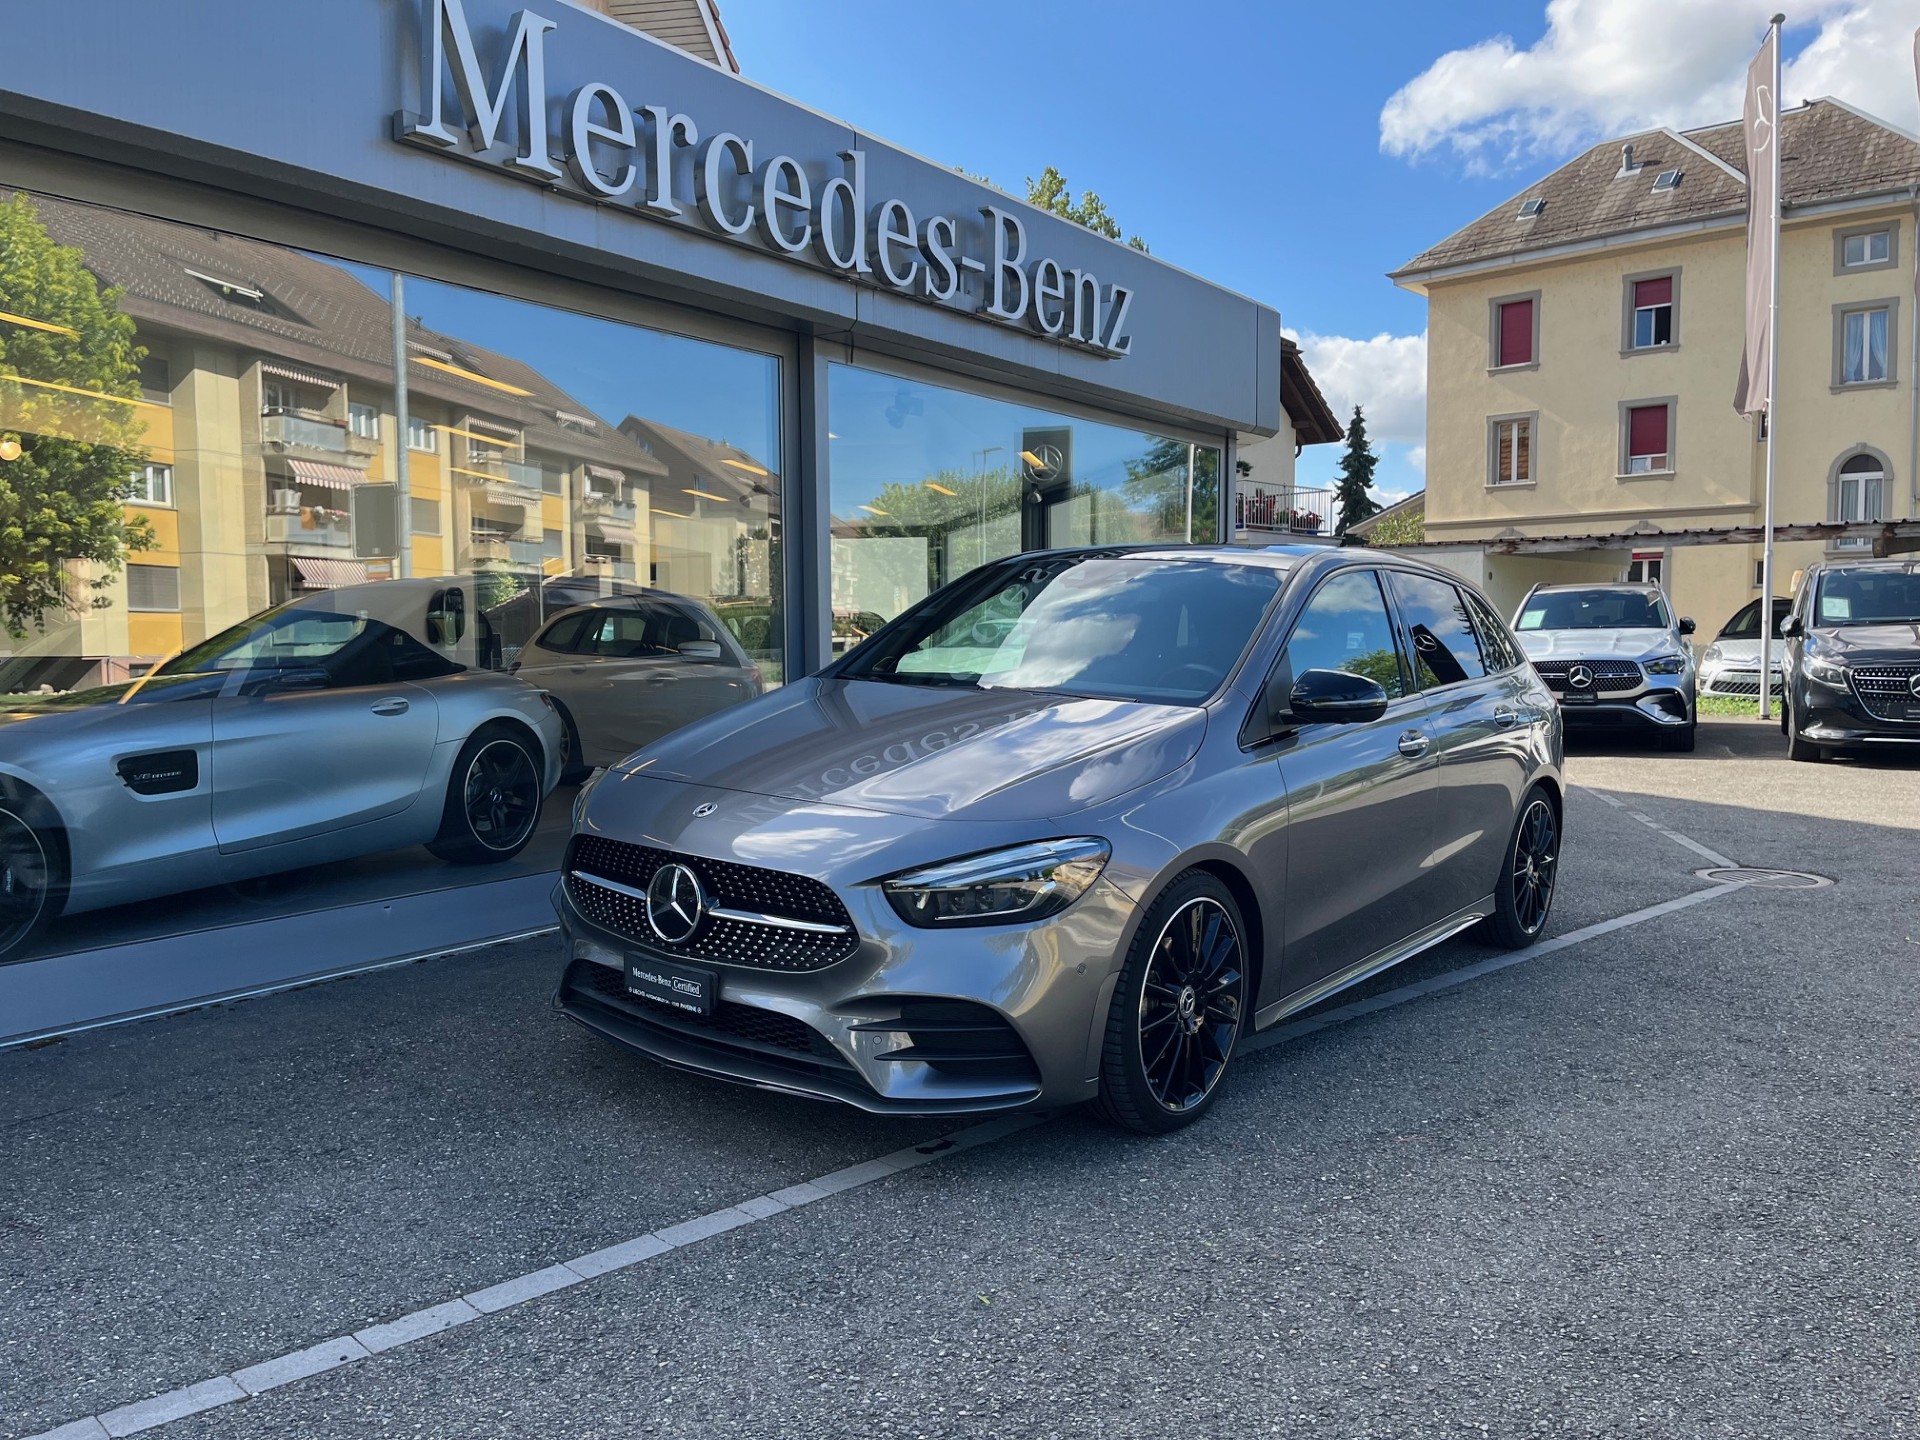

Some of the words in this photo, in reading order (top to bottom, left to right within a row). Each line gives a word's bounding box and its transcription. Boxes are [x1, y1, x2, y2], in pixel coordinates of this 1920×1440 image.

[410, 0, 1135, 356] Mercedes-Benz
[632, 967, 671, 986] Mercedes-Benz
[674, 979, 699, 994] Certified
